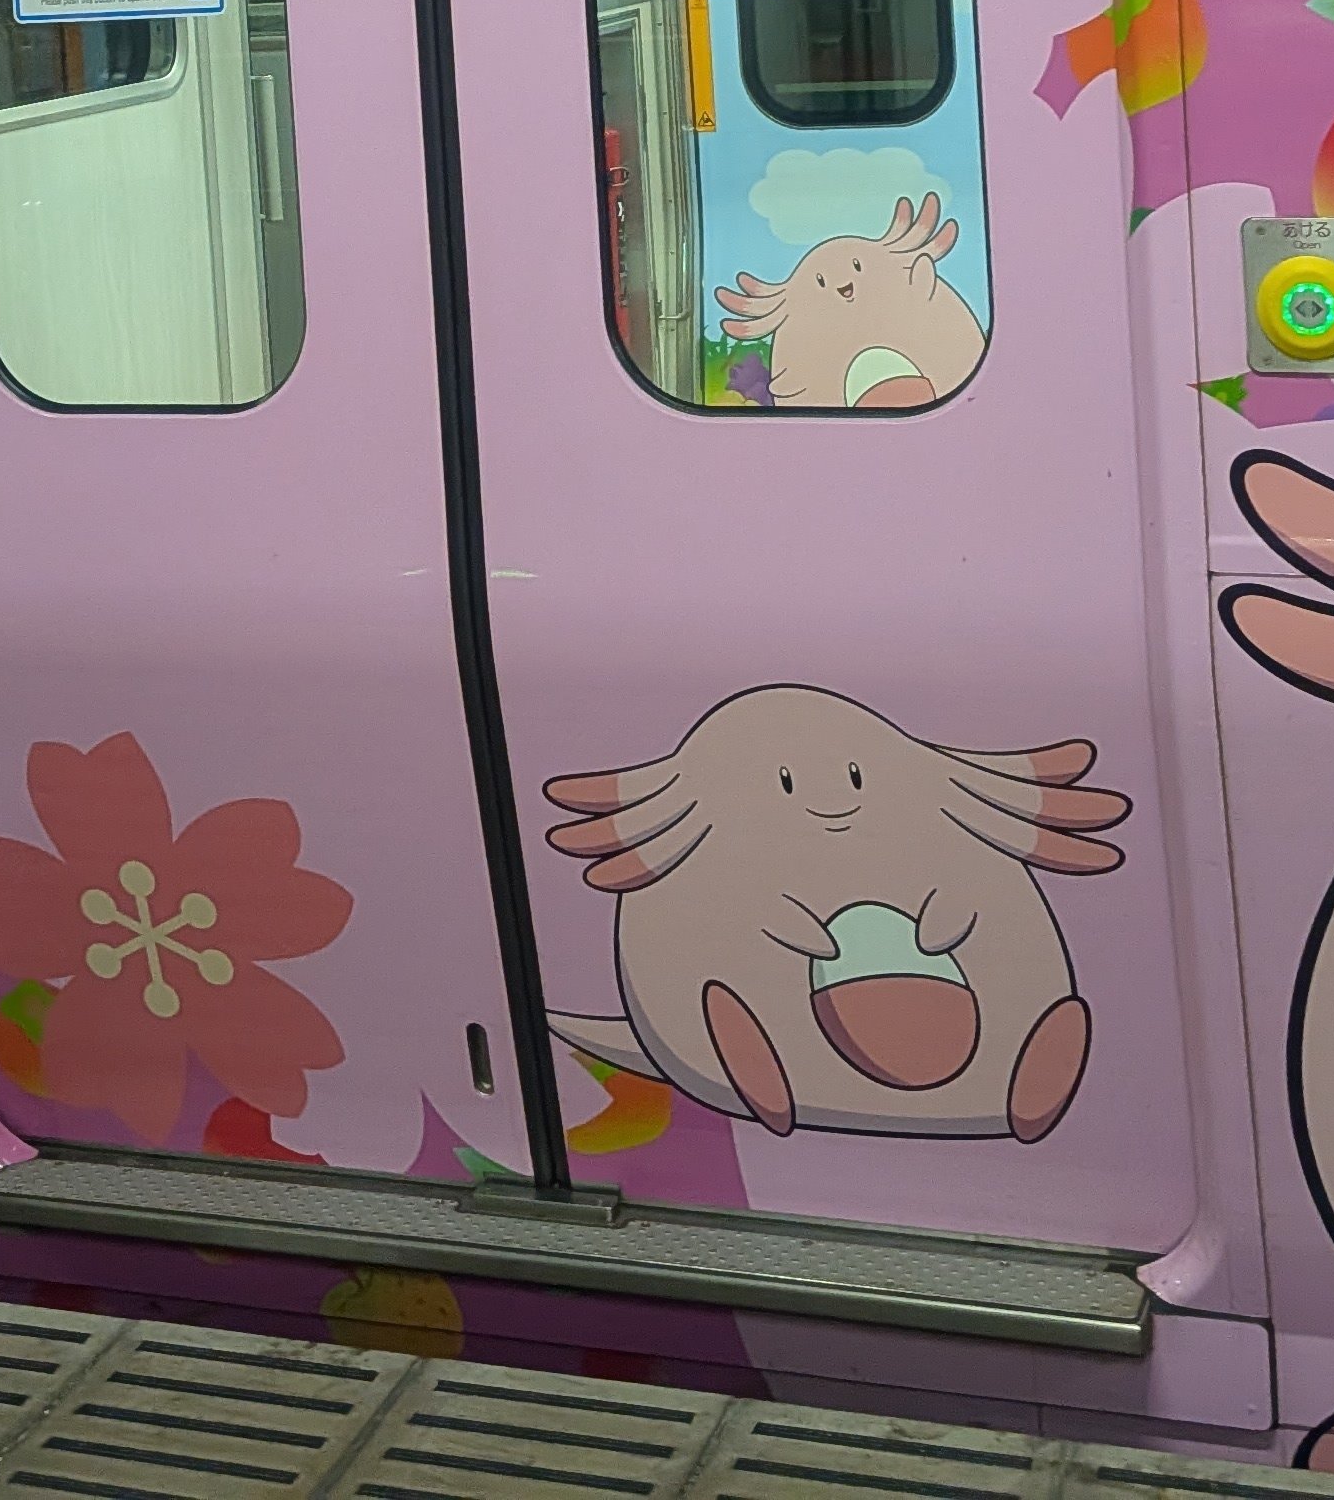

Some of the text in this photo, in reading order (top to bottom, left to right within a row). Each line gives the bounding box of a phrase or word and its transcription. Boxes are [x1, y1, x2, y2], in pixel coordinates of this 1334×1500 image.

[1282, 222, 1331, 238] あける
[1292, 240, 1322, 250] Open
